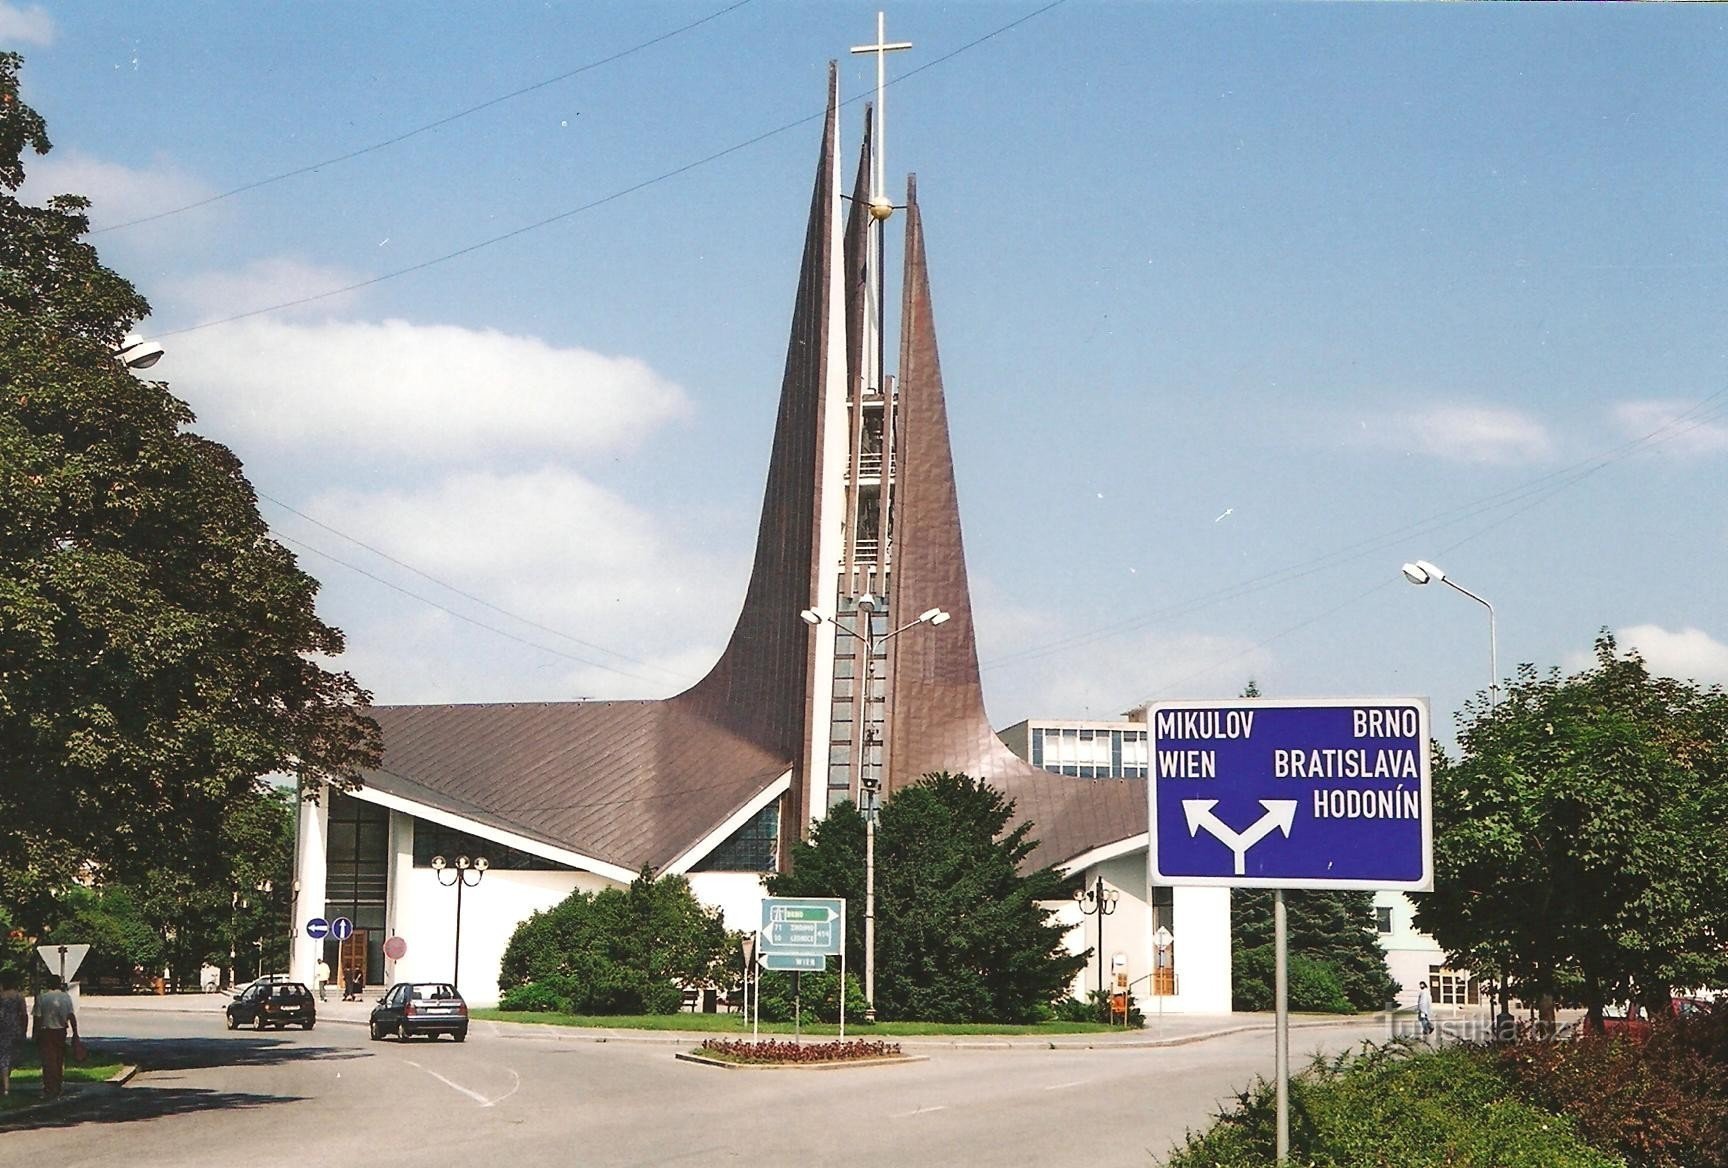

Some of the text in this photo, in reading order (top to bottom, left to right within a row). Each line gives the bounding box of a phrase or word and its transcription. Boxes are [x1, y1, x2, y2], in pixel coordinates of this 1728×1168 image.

[1157, 711, 1254, 740] MIKULOV
[1353, 709, 1417, 738] BRNO
[1158, 750, 1216, 778] WIEN
[1275, 750, 1418, 778] BRATISLAVA
[1314, 784, 1419, 819] HODONÍN
[787, 911, 804, 919] BO
